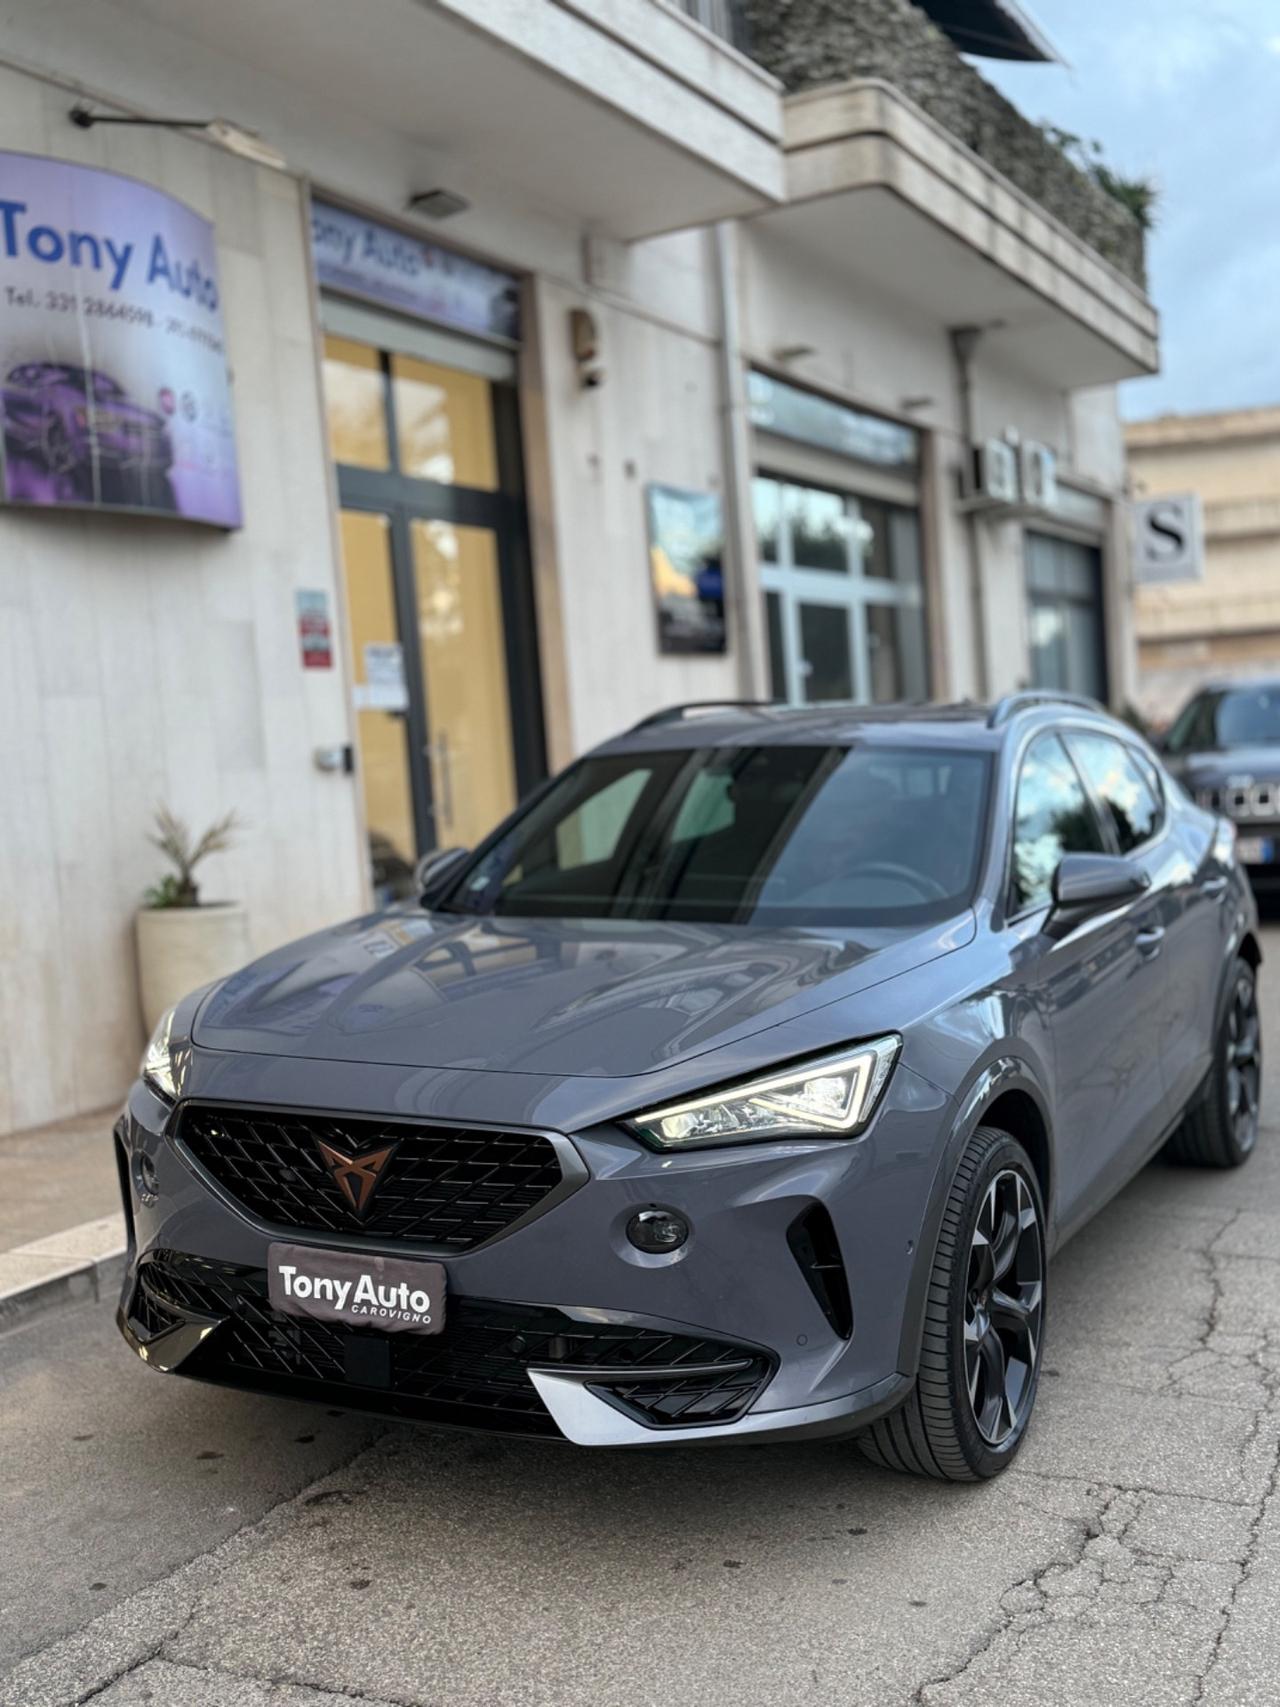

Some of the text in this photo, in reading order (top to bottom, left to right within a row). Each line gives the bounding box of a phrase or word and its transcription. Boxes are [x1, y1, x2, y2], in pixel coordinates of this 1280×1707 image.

[0, 199, 219, 313] Tony Auto
[5, 286, 40, 309] Tel.
[1145, 504, 1185, 561] S
[278, 1265, 430, 1313] Tony Auto
[351, 1304, 432, 1325] CAROVIGNO
